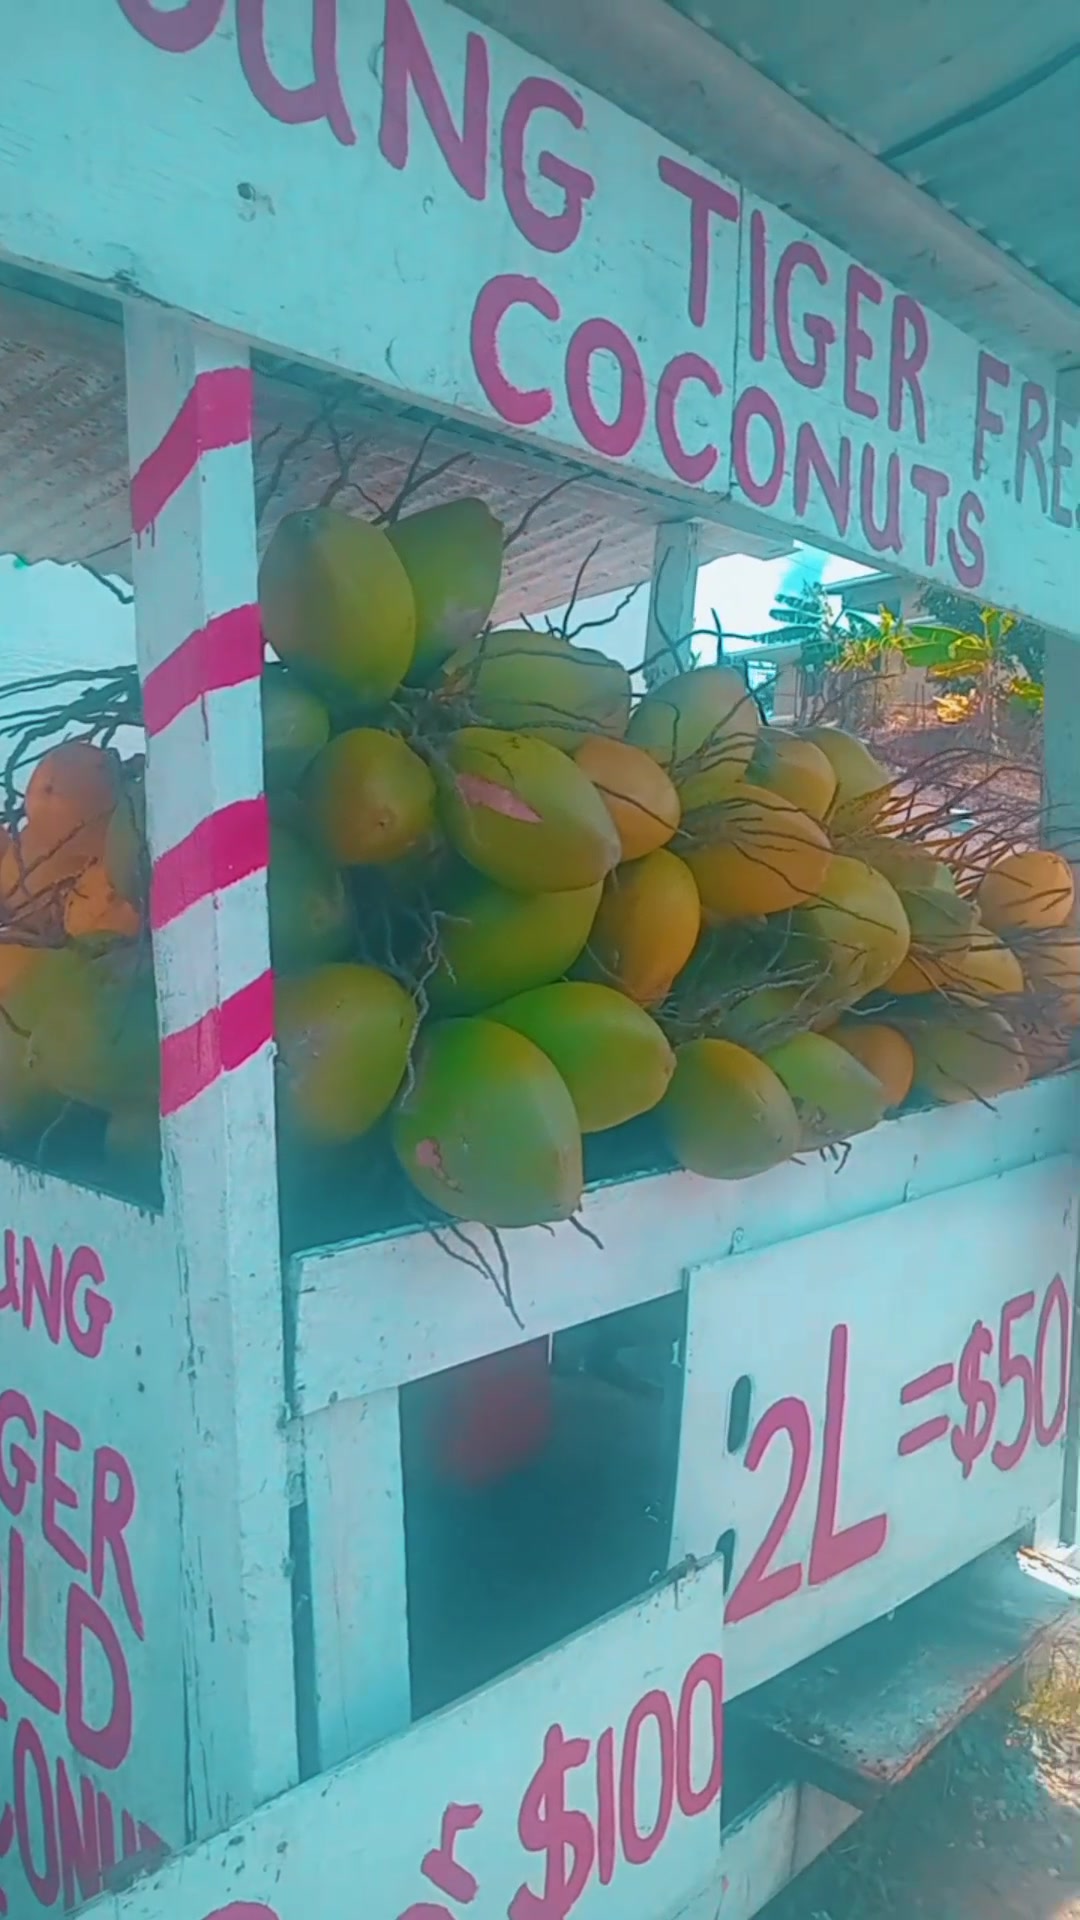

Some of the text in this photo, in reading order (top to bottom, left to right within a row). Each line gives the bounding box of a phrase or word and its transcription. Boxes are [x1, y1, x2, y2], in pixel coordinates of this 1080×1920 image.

[470, 272, 986, 588] COCONUTS
[657, 155, 929, 444] TIGER
[972, 350, 1080, 529] FRE
[507, 1652, 725, 1920] $100
